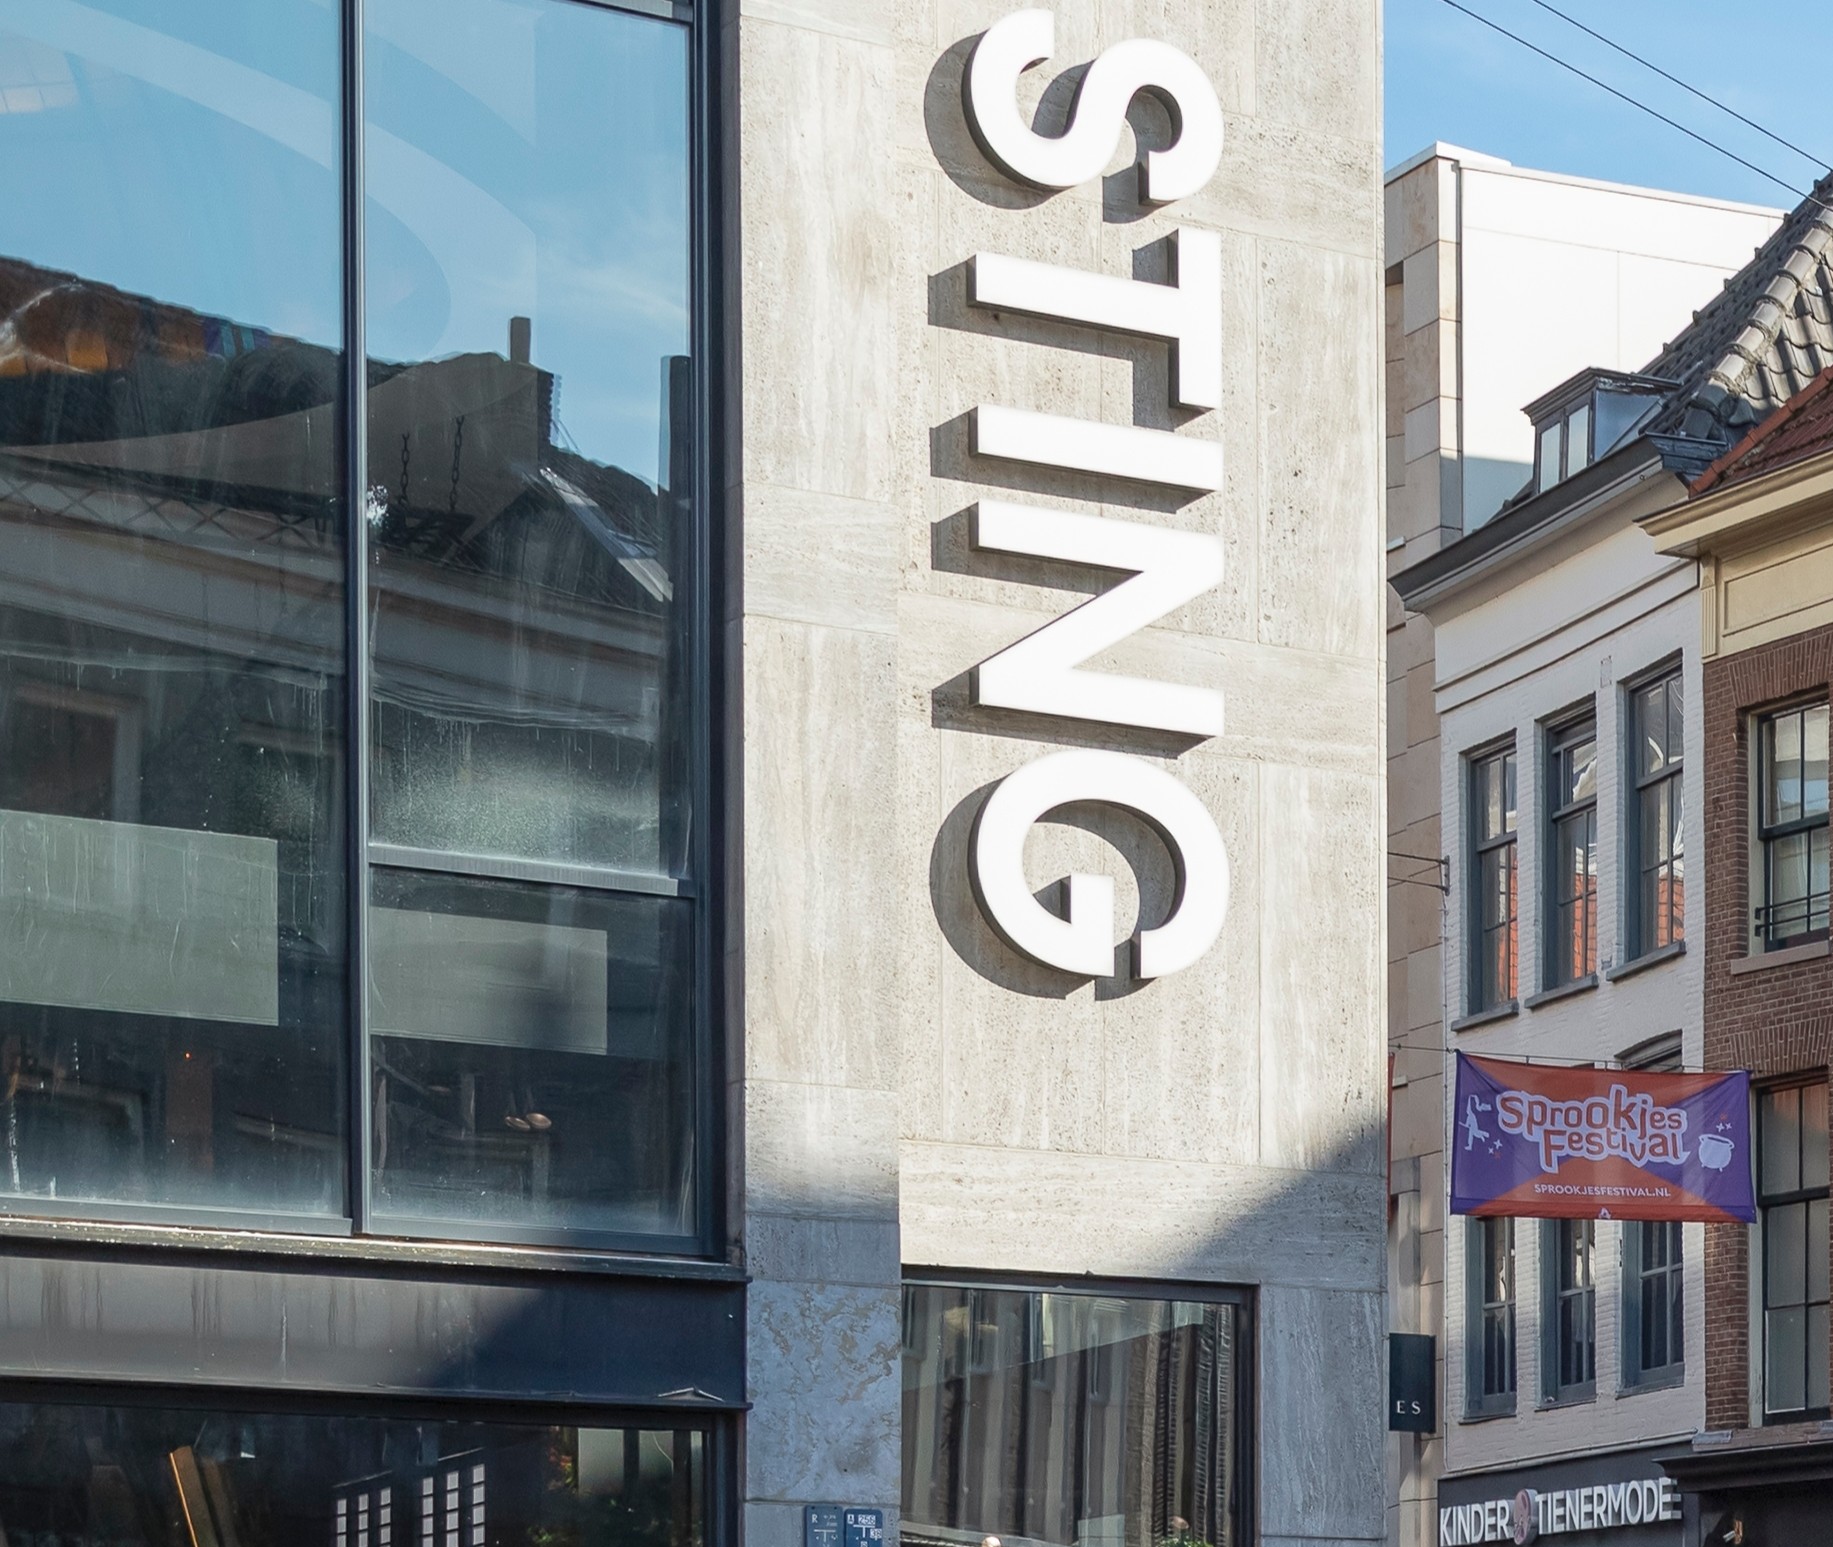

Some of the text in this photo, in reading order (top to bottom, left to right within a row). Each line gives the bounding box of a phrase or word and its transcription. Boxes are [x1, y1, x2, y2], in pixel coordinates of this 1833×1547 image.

[965, 9, 1231, 981] STING
[1499, 1088, 1684, 1140] Sprookjes
[1542, 1126, 1681, 1168] Festival
[1534, 1183, 1671, 1198] SPROOKJESFESTIVAL.NL
[1440, 1477, 1681, 1547] KINDER TIENERMODE
